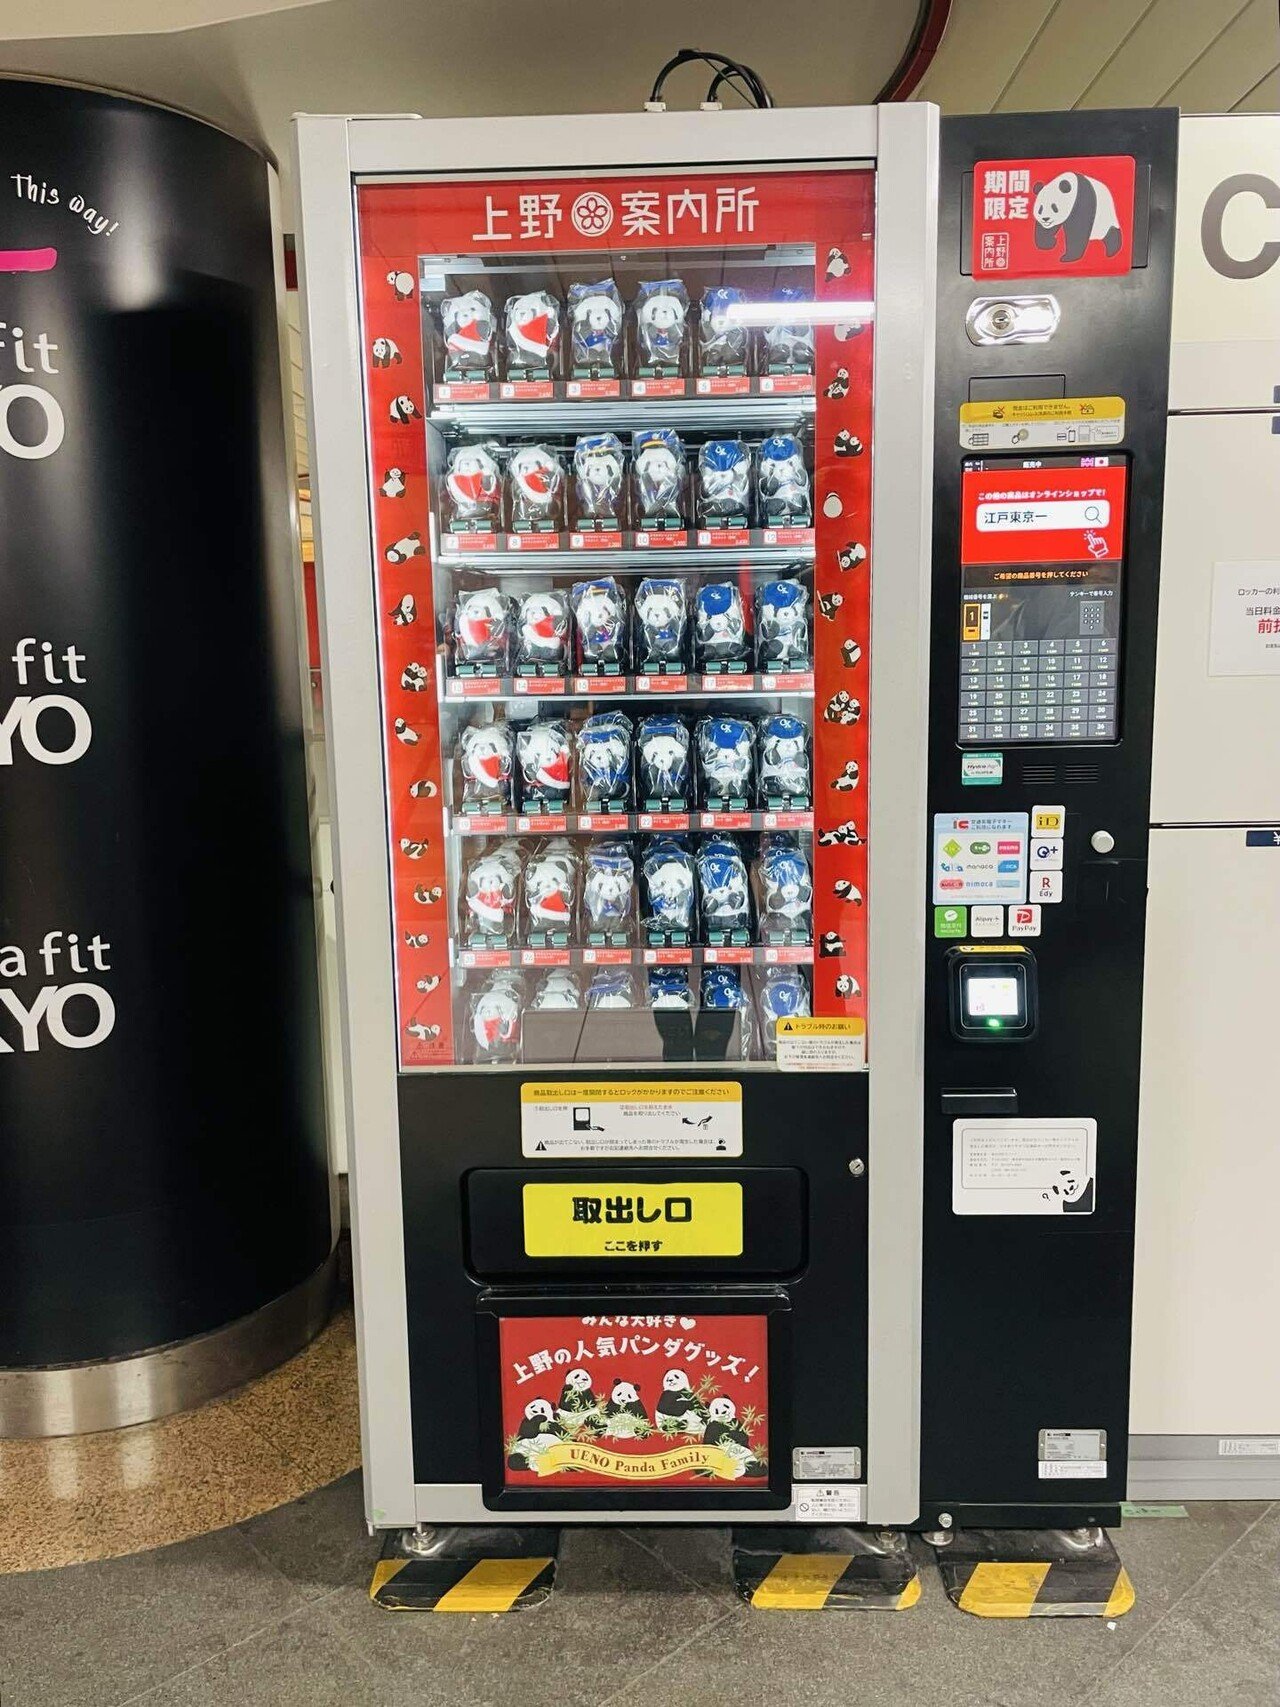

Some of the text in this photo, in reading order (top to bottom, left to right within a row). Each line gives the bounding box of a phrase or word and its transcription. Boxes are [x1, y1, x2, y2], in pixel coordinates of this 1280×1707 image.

[984, 169, 1030, 195] 期間
[11, 174, 120, 237] This way!
[472, 186, 760, 242] 上野 案内所
[984, 197, 1029, 220] 限定
[0, 322, 59, 374] it
[0, 383, 65, 460] O
[994, 571, 1089, 580] ご希望の商品番号を押してください
[969, 611, 974, 621] 1
[1246, 605, 1280, 616] 当日料金
[12, 637, 87, 685] fit
[1039, 816, 1059, 826] iD
[1042, 877, 1051, 888] R
[0, 931, 111, 977] a fit
[572, 1196, 692, 1224] 取出し口
[604, 1240, 663, 1252] ここを押す
[512, 1335, 760, 1385] 上野の人気パンダグッズ!
[570, 1448, 710, 1473] UENO Panda Family
